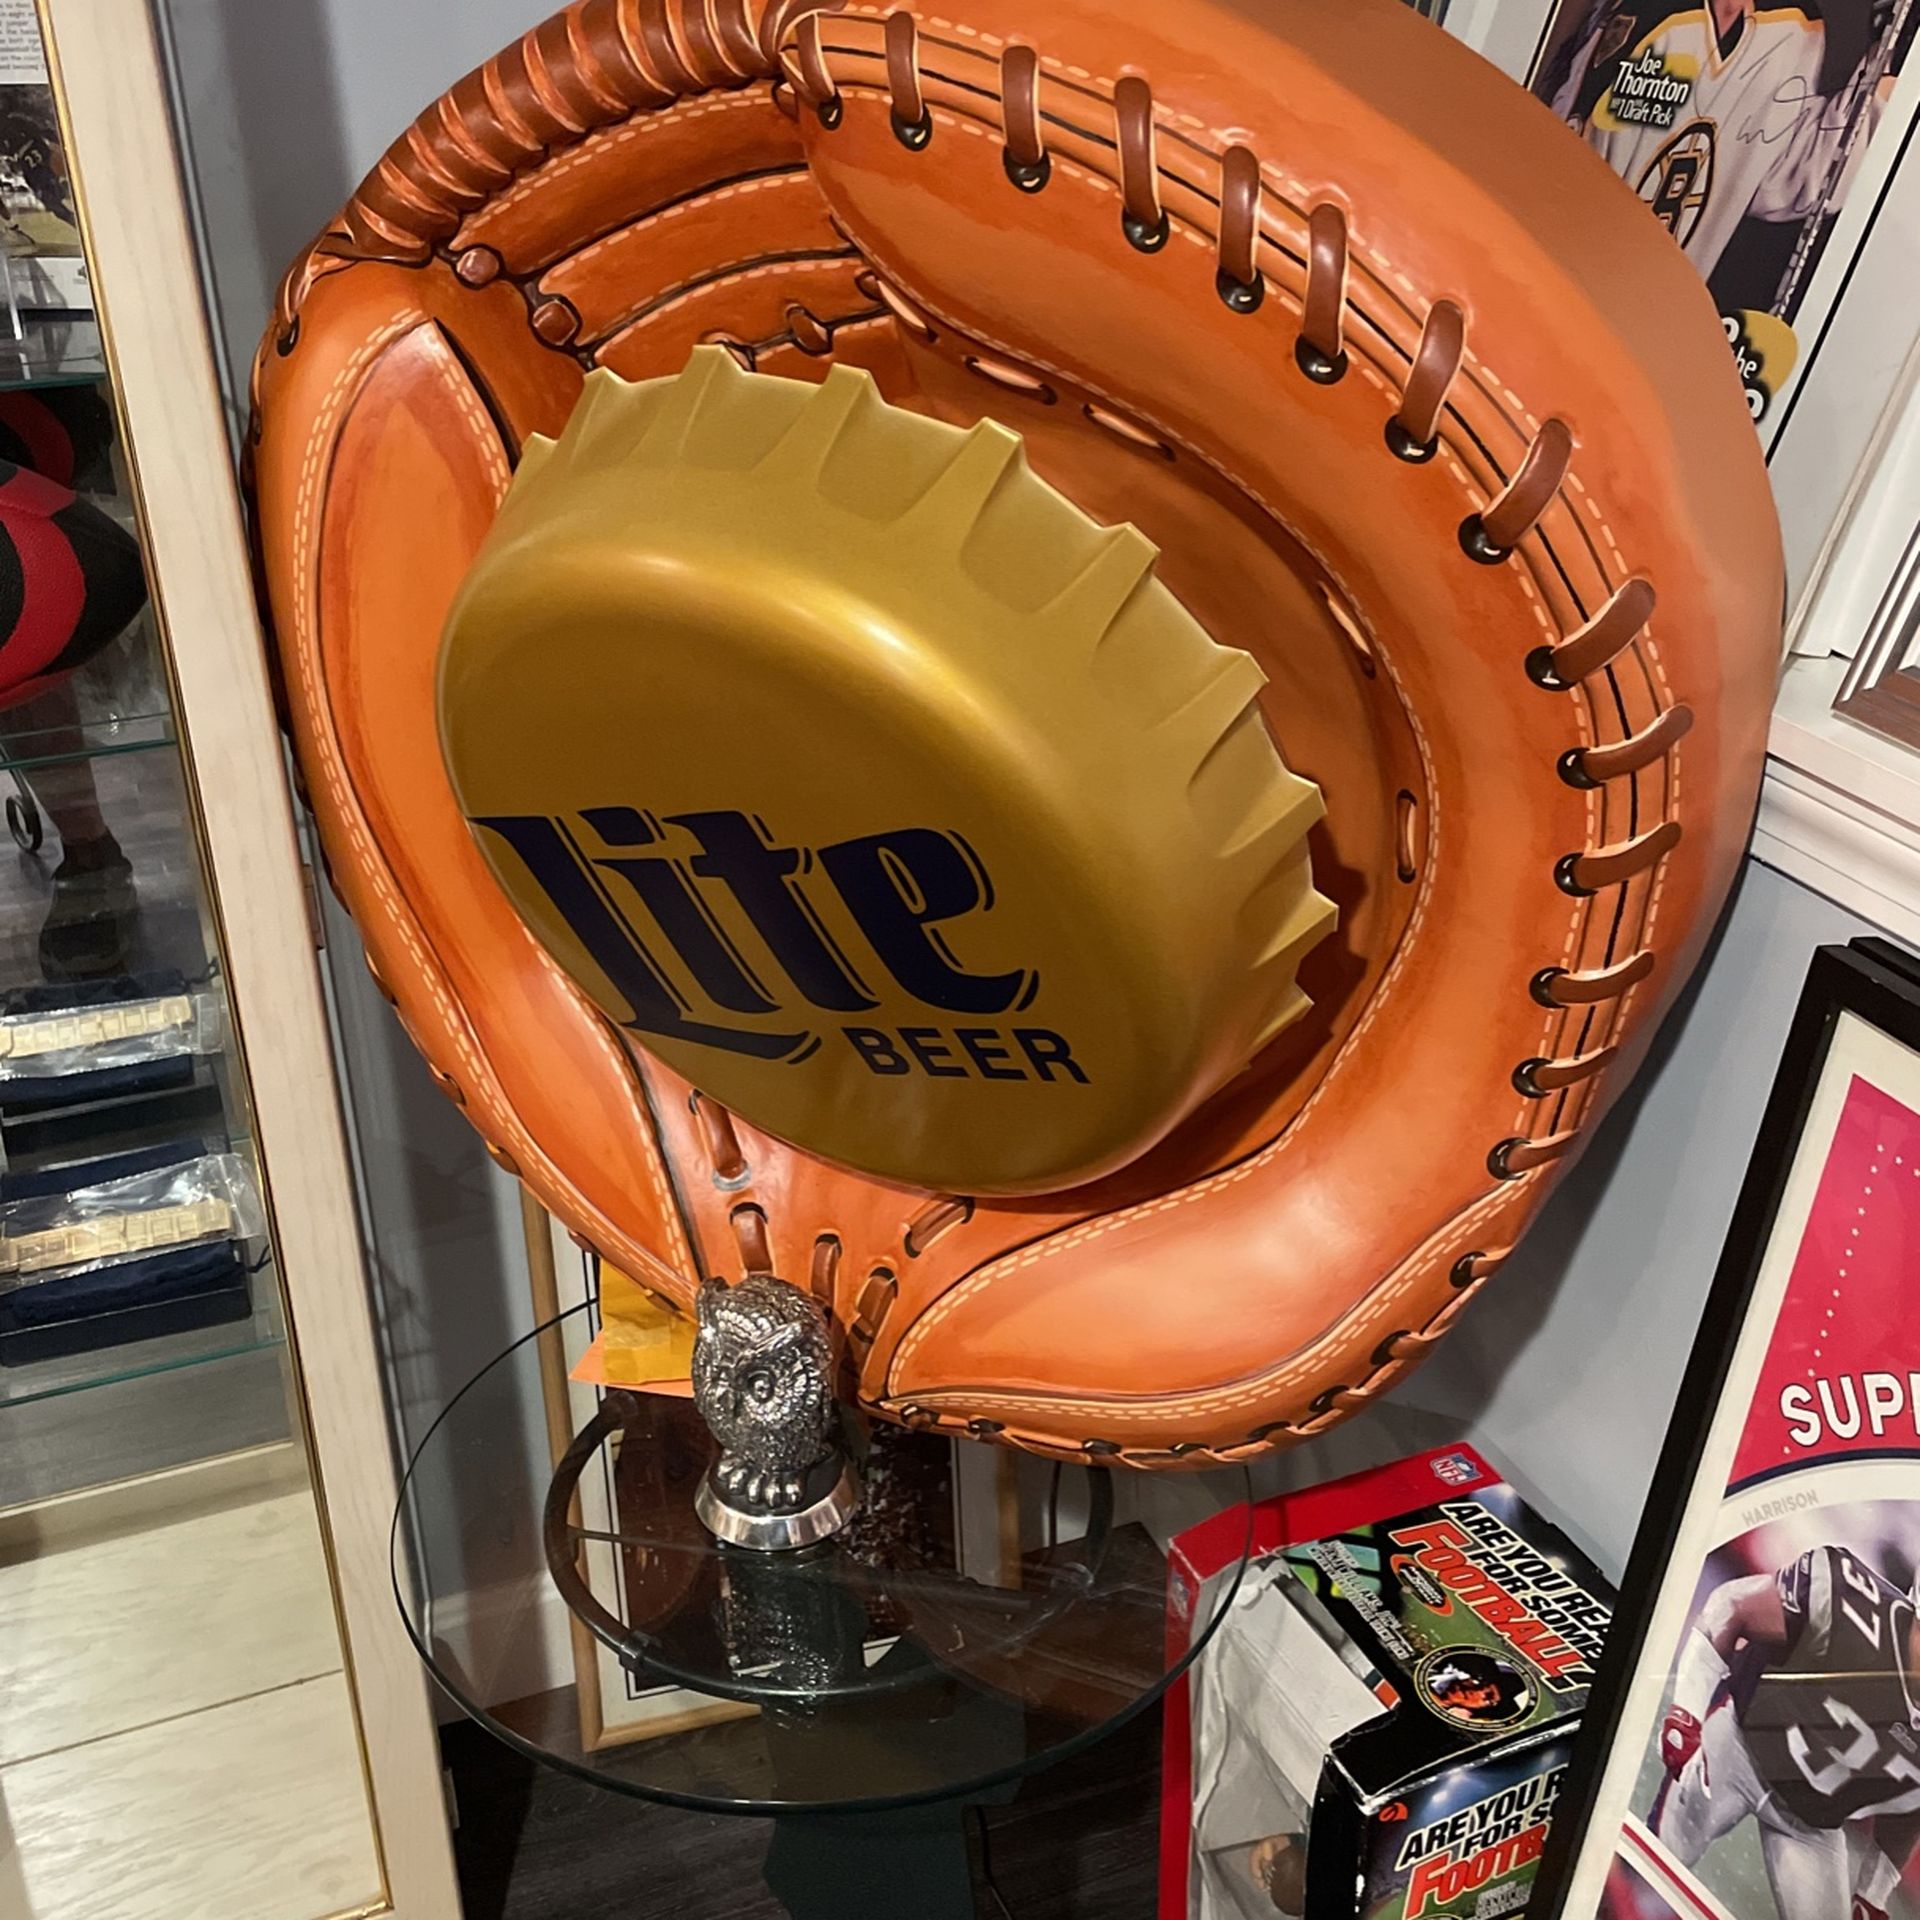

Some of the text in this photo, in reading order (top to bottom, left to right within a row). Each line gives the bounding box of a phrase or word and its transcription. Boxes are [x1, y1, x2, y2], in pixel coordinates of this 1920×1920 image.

[1612, 61, 1689, 104] Thornton
[1634, 48, 1662, 75] Joe
[1623, 99, 1650, 122] Draft
[1648, 104, 1673, 126] Pick
[840, 1026, 1092, 1084] BEER
[1741, 1489, 1820, 1528] HARRISON
[1439, 1502, 1518, 1553] ARE
[1501, 1543, 1575, 1593] YOU
[1468, 1550, 1531, 1596] FOR
[1395, 1811, 1471, 1871] ARE
[1475, 1776, 1542, 1832] YOU
[1462, 1814, 1524, 1859] FOR
